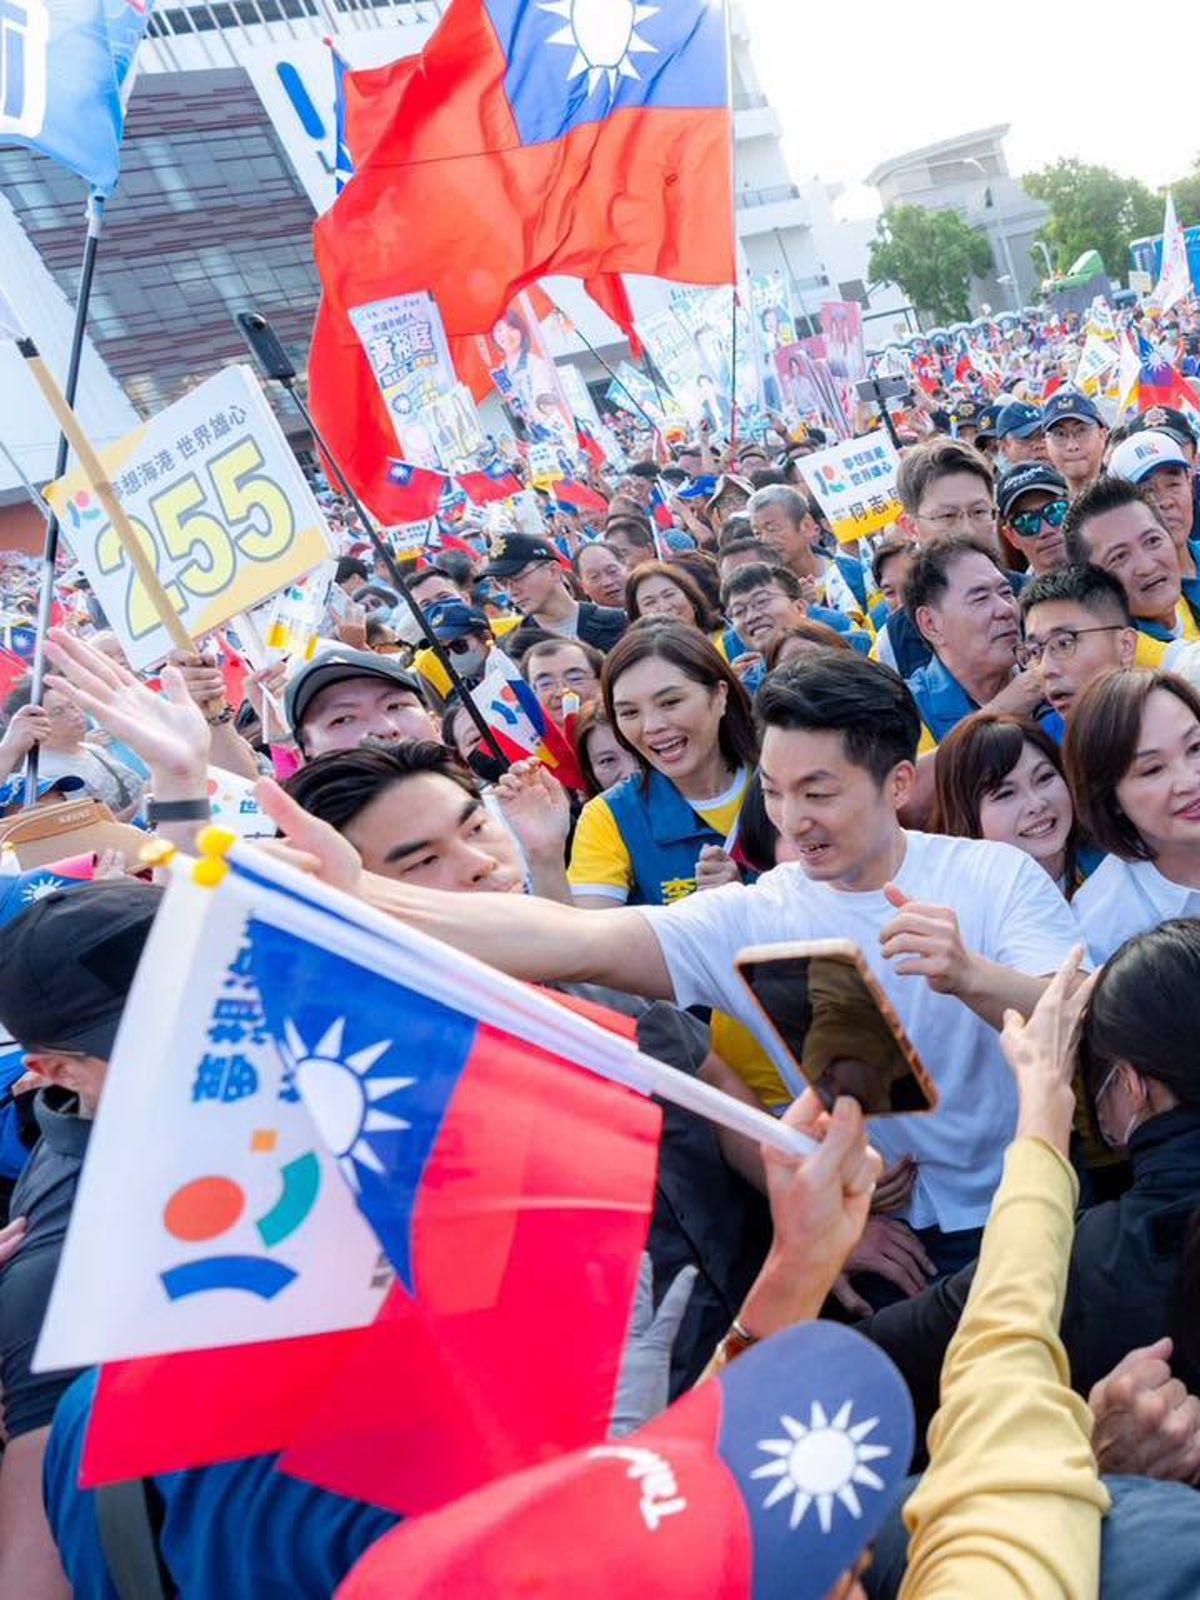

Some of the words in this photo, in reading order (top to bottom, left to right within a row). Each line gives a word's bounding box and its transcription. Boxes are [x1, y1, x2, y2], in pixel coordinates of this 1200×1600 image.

[175, 405, 248, 461] 世界雄心
[94, 433, 296, 641] 255
